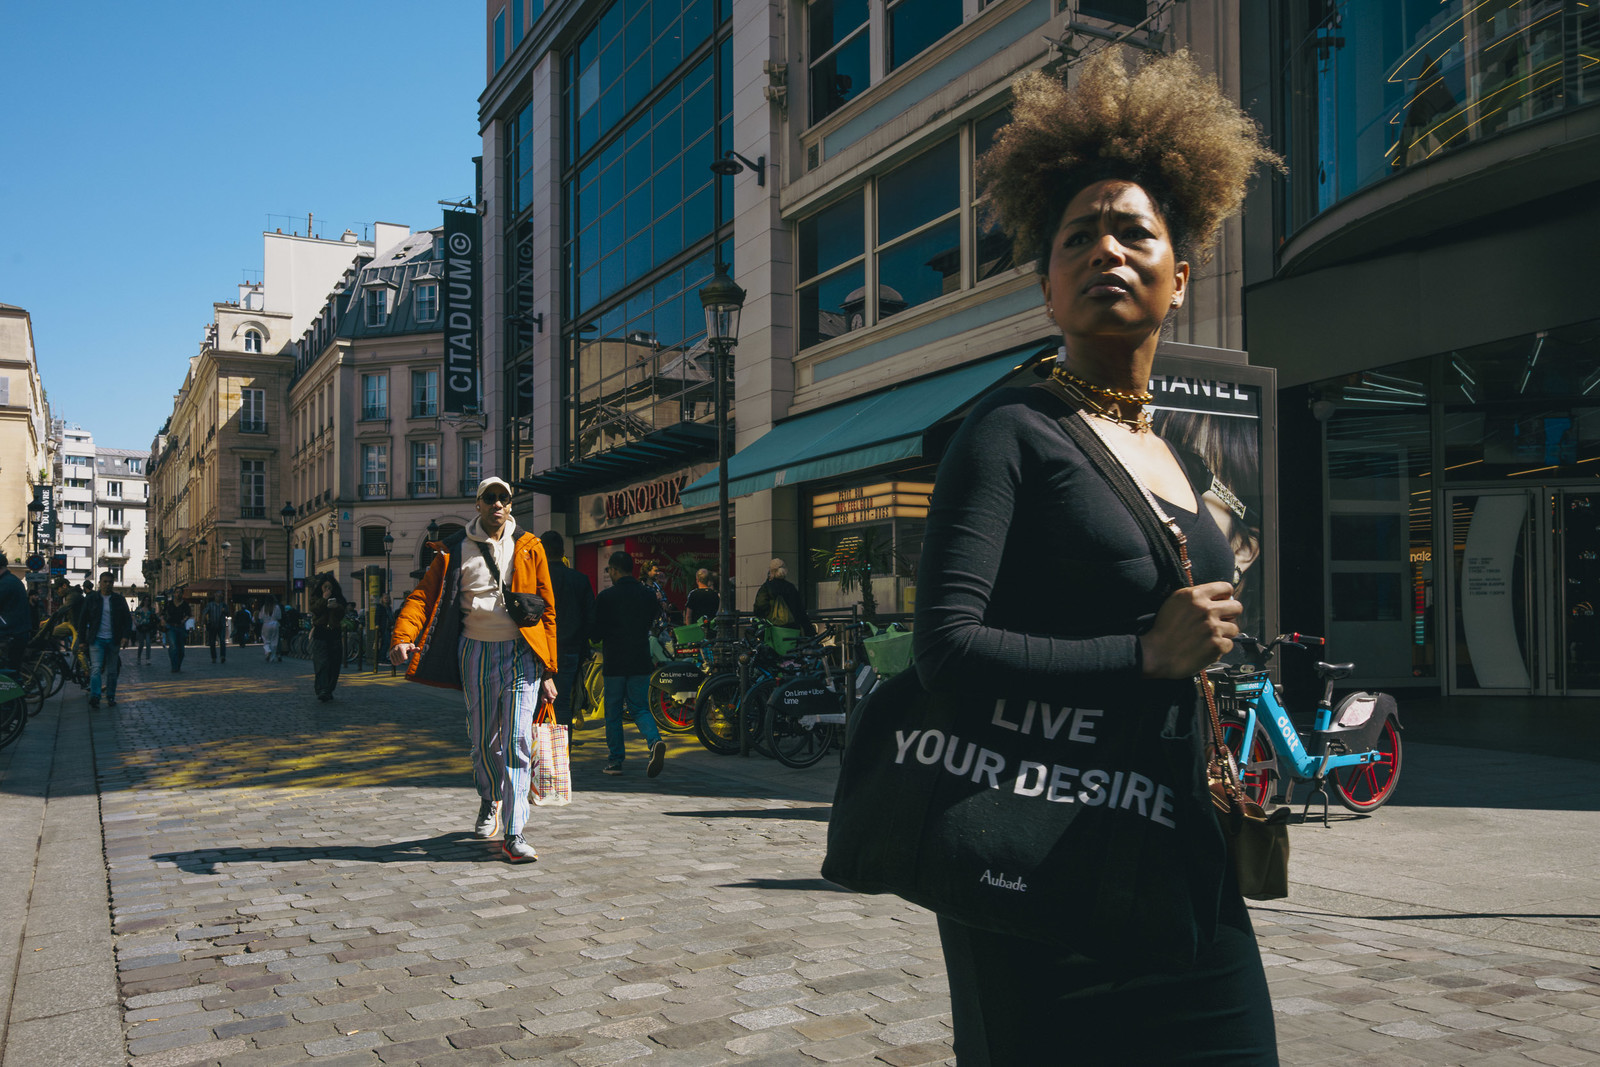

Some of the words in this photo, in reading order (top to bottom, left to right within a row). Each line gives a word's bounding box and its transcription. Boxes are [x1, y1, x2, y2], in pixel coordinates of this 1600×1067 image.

[1148, 375, 1249, 401] HANEL
[606, 476, 687, 521] MONOPRIX
[638, 535, 685, 545] MONOPRIX
[794, 689, 808, 697] Lime
[991, 698, 1104, 744] LIVE
[1277, 716, 1299, 753] dott
[894, 729, 1006, 790] YOUR
[1013, 760, 1177, 830] DESIRE
[979, 869, 1028, 893] Aubade
